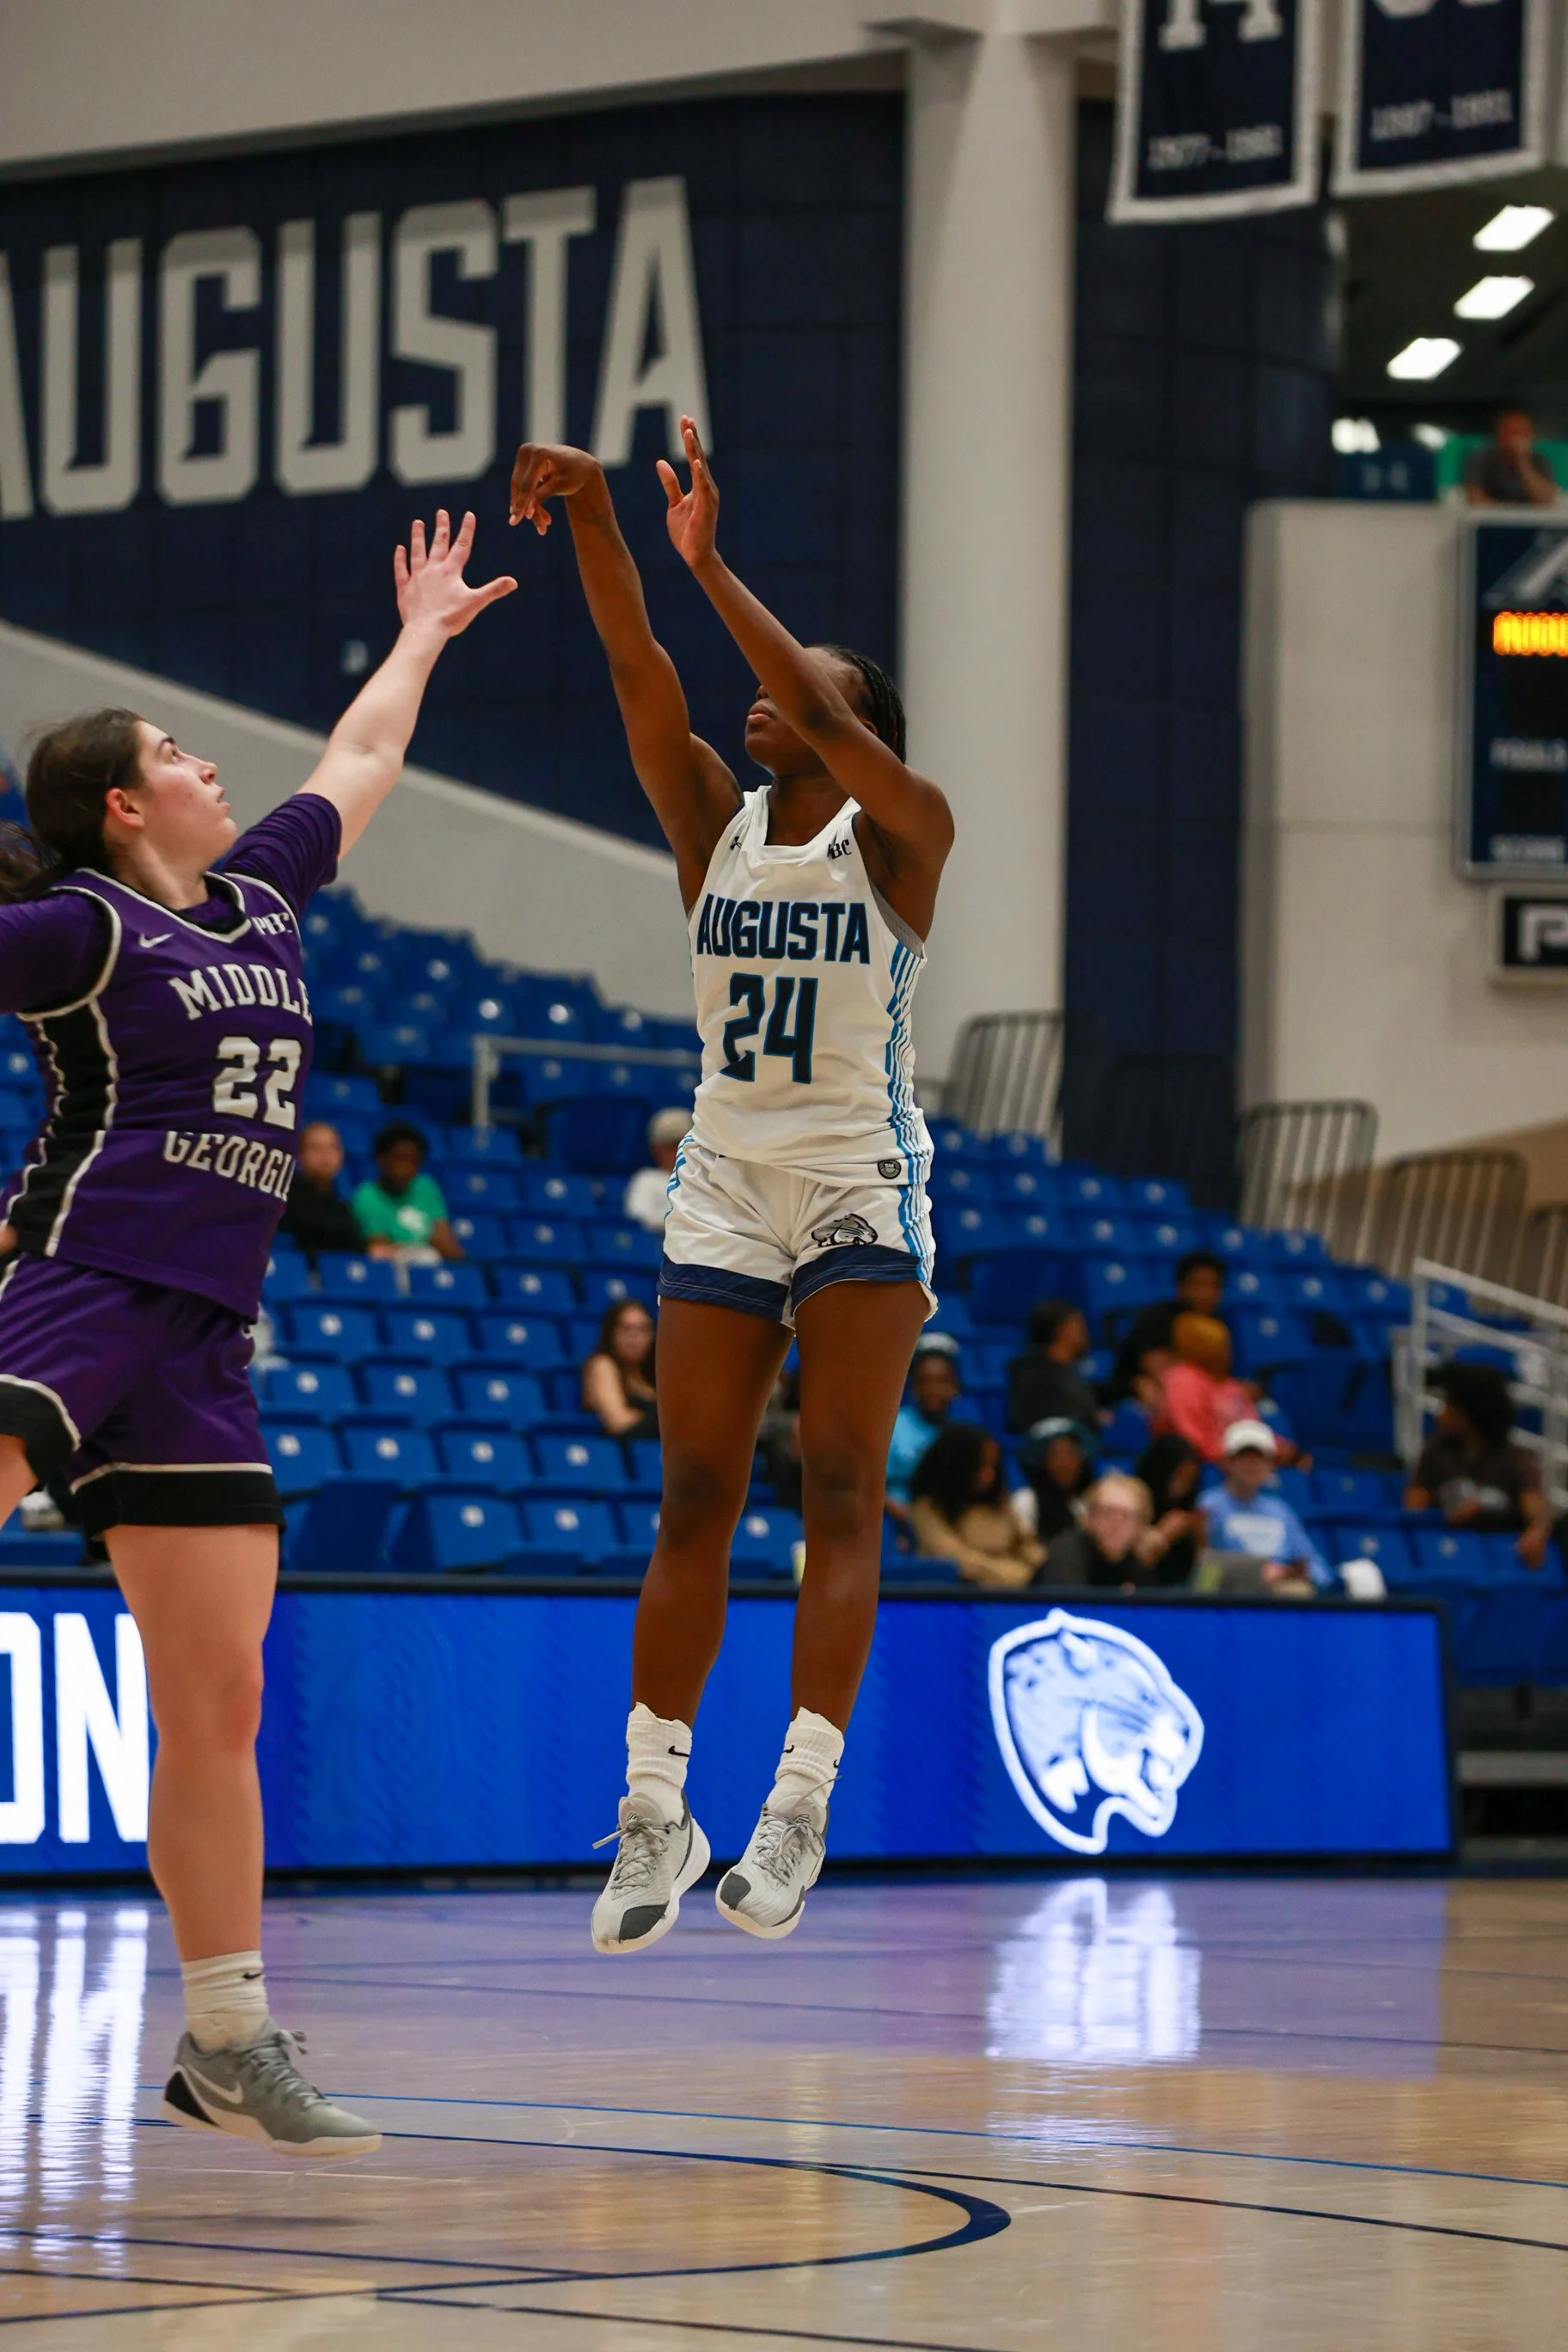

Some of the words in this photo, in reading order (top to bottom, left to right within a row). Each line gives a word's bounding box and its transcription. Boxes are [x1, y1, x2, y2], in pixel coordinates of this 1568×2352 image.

[696, 893, 871, 965] AUGUSTA
[719, 971, 818, 1084] 24
[213, 1036, 302, 1130] 22
[163, 1130, 296, 1202] GEORGI
